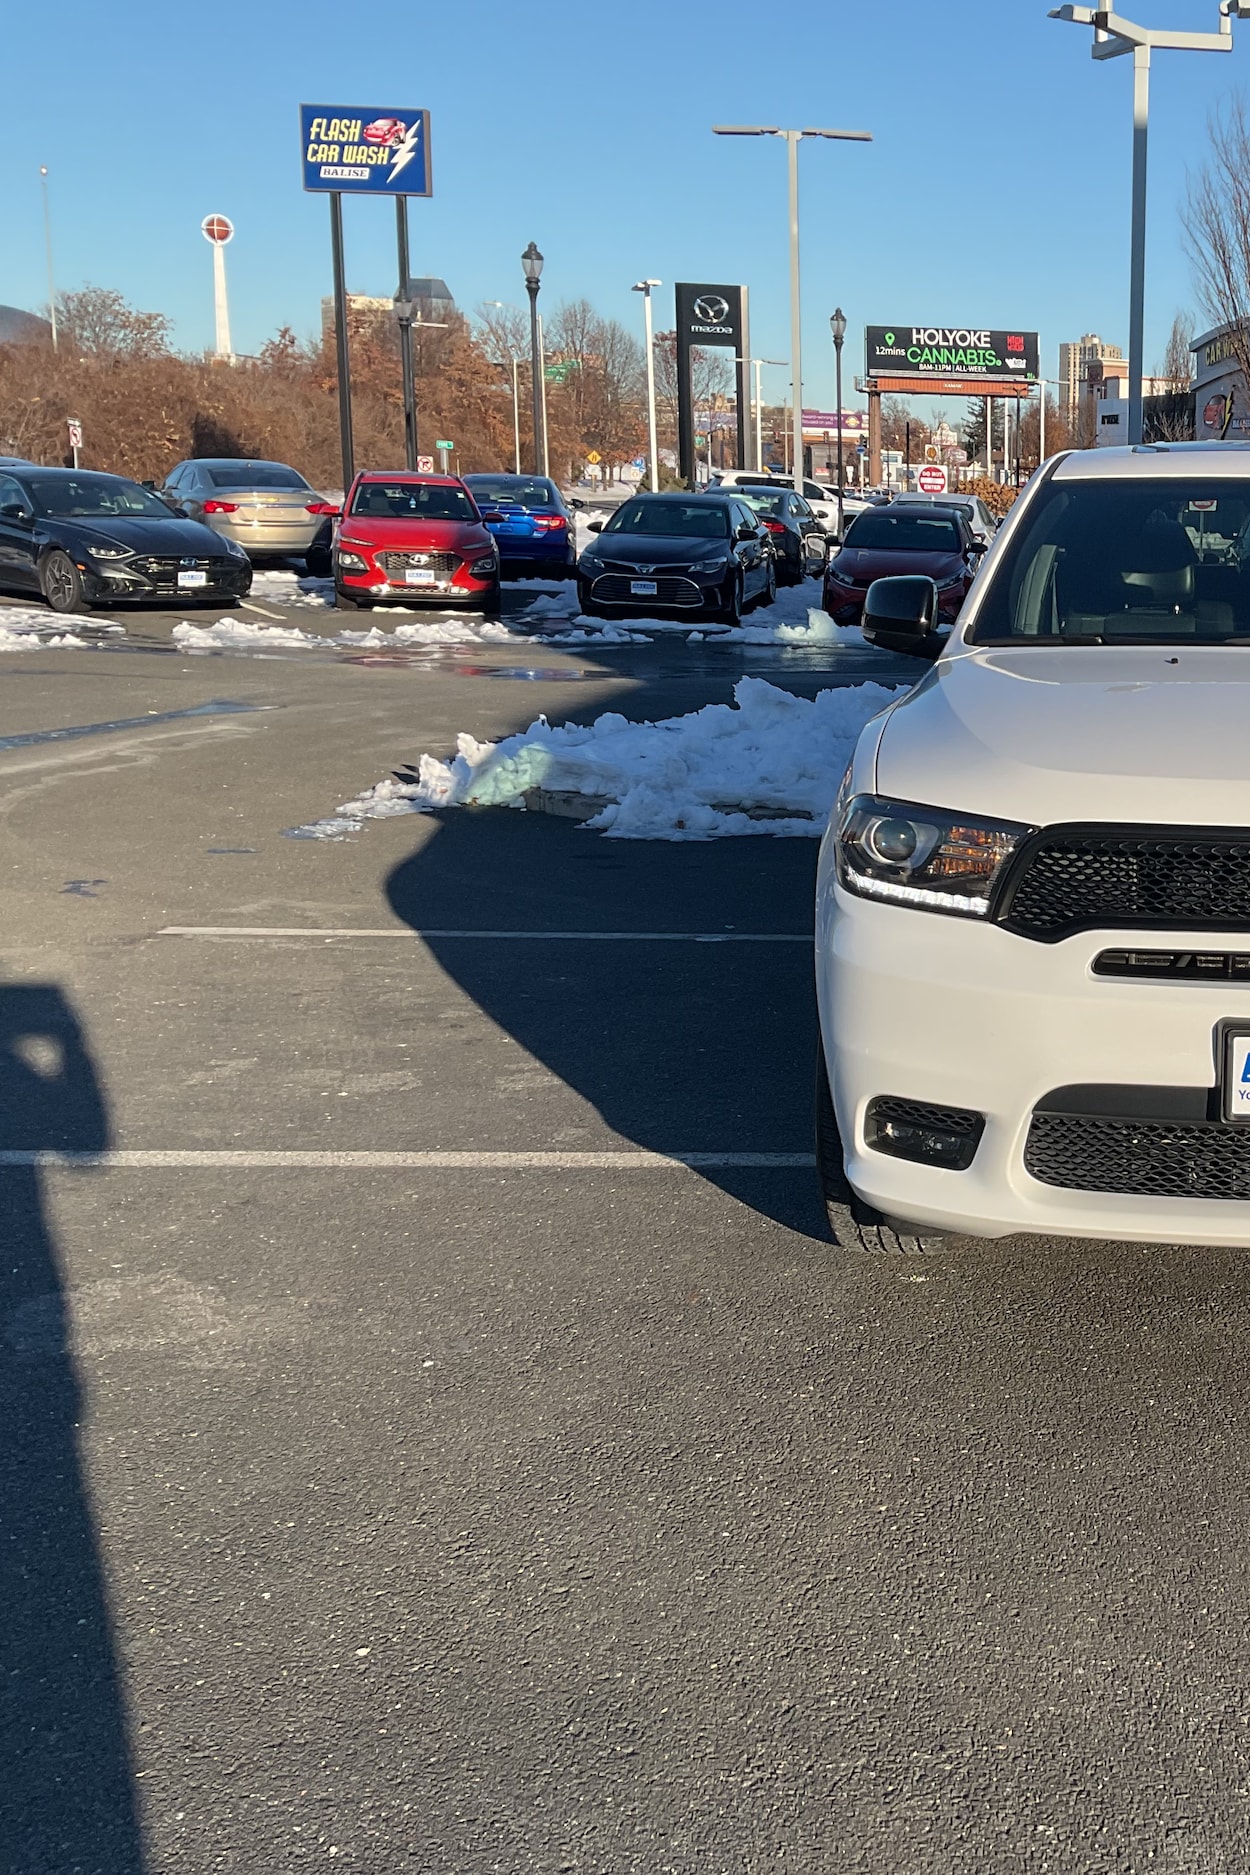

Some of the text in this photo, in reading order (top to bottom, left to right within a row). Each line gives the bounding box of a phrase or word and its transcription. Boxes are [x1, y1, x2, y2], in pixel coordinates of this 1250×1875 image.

[310, 118, 361, 142] FLASH
[307, 143, 389, 165] CAR WASH
[323, 167, 368, 178] BALISE
[912, 328, 991, 348] HOLYOKE
[875, 346, 906, 356] 12mins
[1205, 342, 1221, 366] CAR
[919, 364, 987, 373] 8AM-11PM ALL-WEEK
